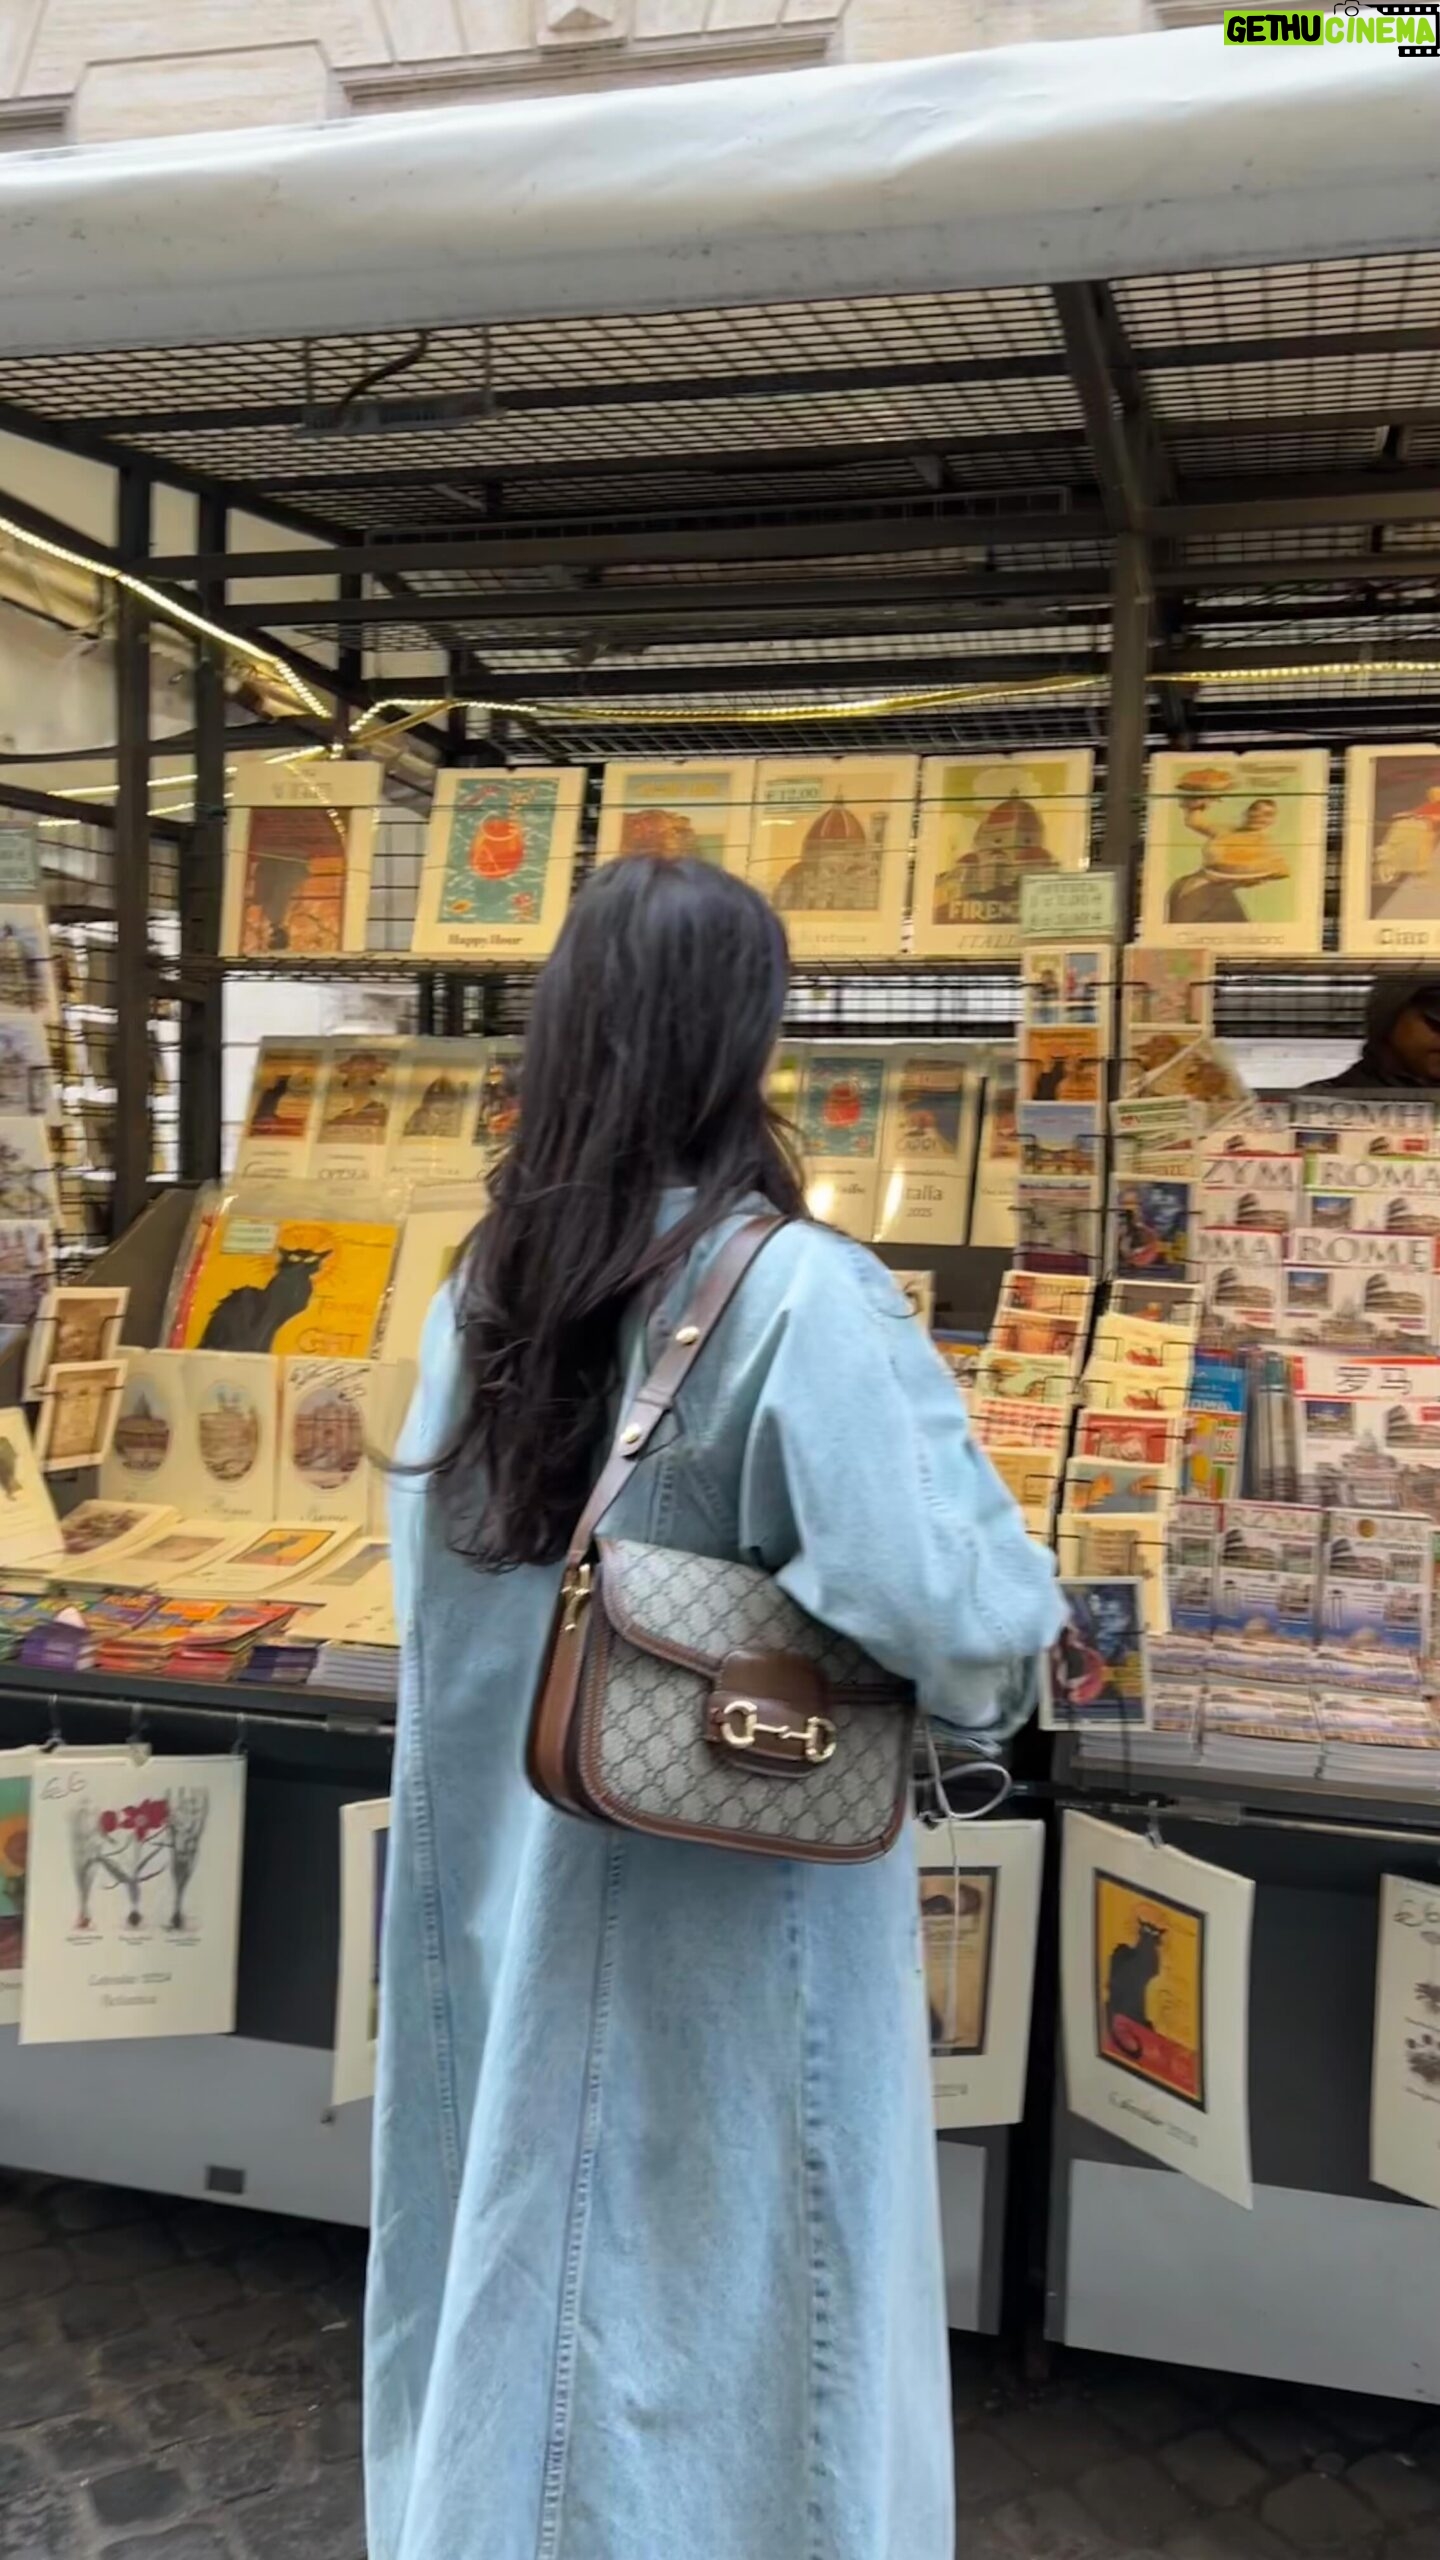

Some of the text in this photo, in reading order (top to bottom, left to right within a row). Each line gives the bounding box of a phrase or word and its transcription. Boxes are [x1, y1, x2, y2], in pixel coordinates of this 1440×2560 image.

[1201, 1157, 1294, 1189] ZYM
[1299, 1234, 1428, 1268] ROME
[1335, 1365, 1413, 1396] 罗马
